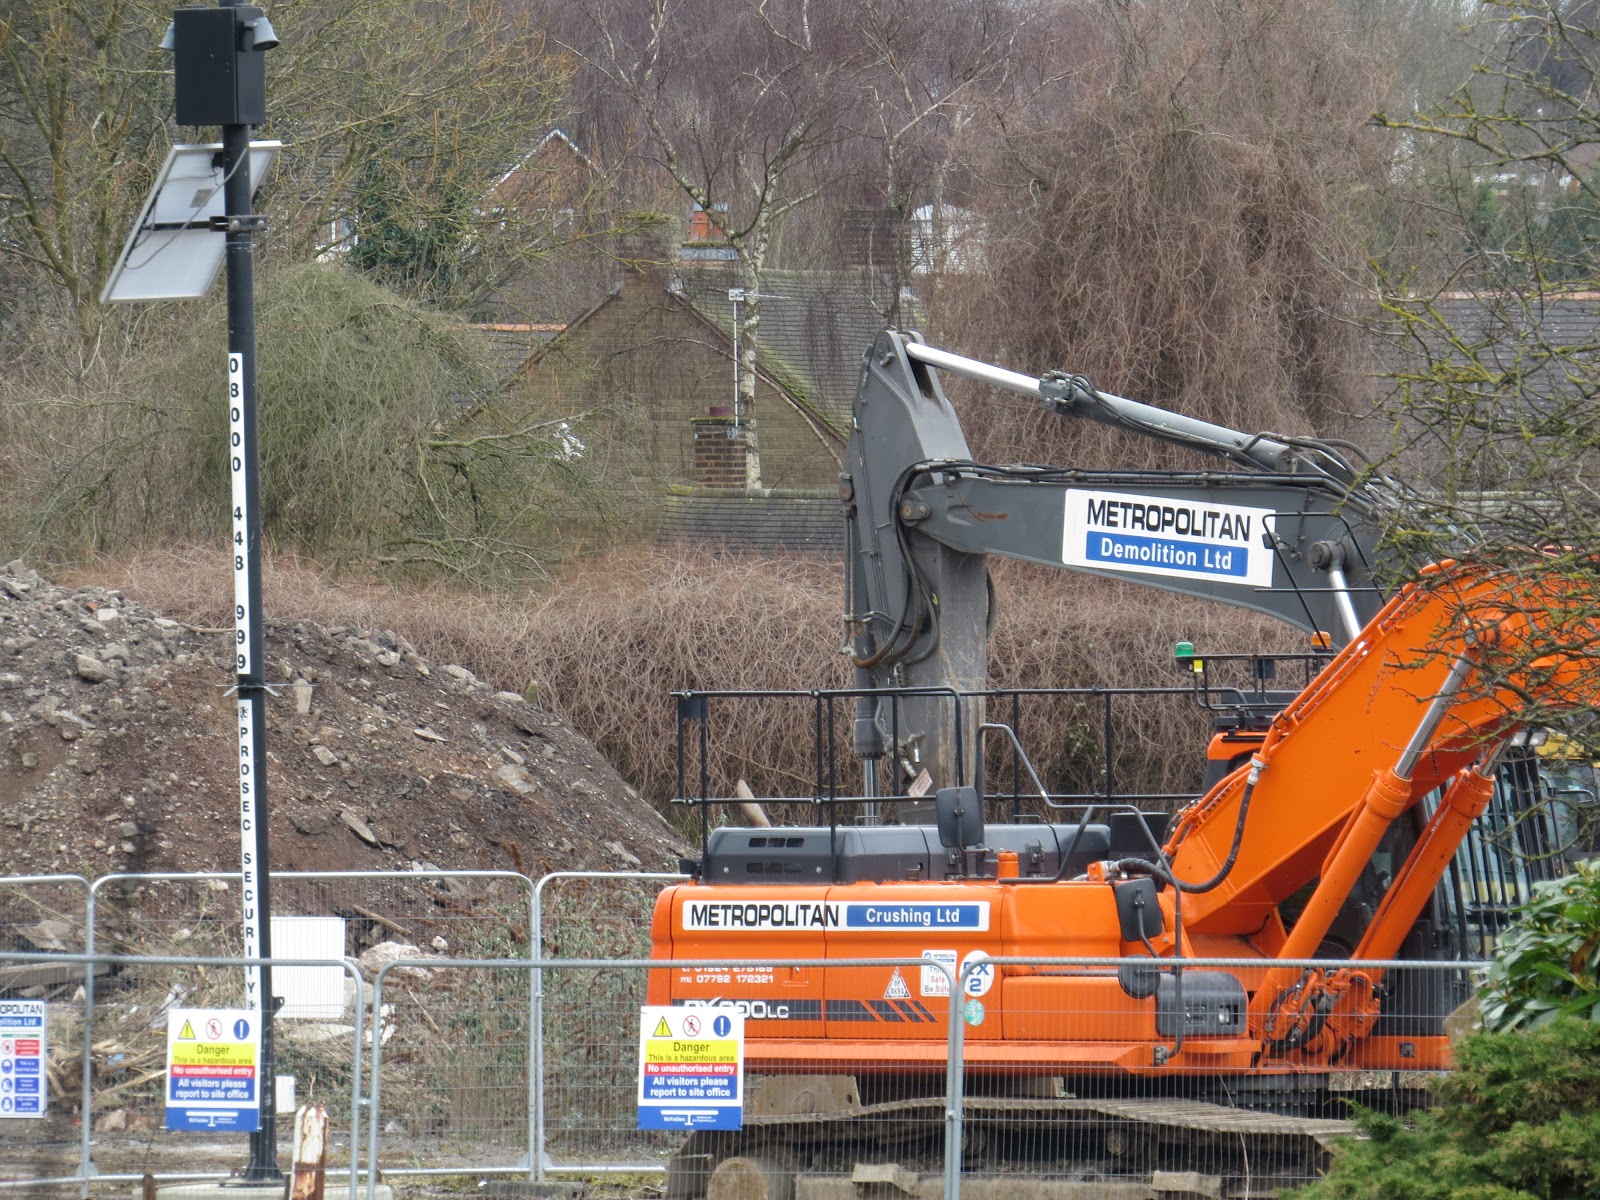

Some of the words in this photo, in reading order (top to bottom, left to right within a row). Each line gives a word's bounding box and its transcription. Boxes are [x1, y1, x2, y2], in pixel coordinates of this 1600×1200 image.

[229, 357, 242, 472] 08000
[1086, 498, 1251, 542] METROPOLITAN
[233, 506, 244, 571] 448
[1101, 537, 1197, 567] Demolition
[1204, 548, 1232, 570] Ltd
[236, 604, 247, 669] 999
[690, 904, 839, 927] METROPOLITAN
[866, 907, 931, 926] Crushing
[936, 907, 960, 923] Ltd
[969, 977, 982, 992] 2
[196, 1044, 230, 1057] Danger
[673, 1041, 710, 1055] Danger
[174, 1056, 188, 1064] This
[203, 1056, 236, 1064] hazardous
[649, 1054, 664, 1062] This
[680, 1054, 717, 1062] hazardous
[173, 1066, 184, 1075] No
[185, 1066, 233, 1075] unauthorised
[233, 1067, 253, 1077] entry
[648, 1064, 659, 1073] No
[661, 1064, 713, 1073] unauthorised
[714, 1065, 735, 1075] entry
[178, 1078, 190, 1088] All
[191, 1079, 220, 1088] visitors
[221, 1079, 247, 1090] please
[653, 1077, 665, 1086] All
[667, 1077, 698, 1086] visitors
[701, 1077, 729, 1088] please
[175, 1089, 200, 1099] report
[201, 1090, 210, 1098] to
[210, 1089, 226, 1099] site
[226, 1089, 249, 1099] office
[650, 1088, 676, 1098] report
[678, 1088, 687, 1097] to
[688, 1088, 705, 1097] site
[706, 1087, 731, 1097] office
